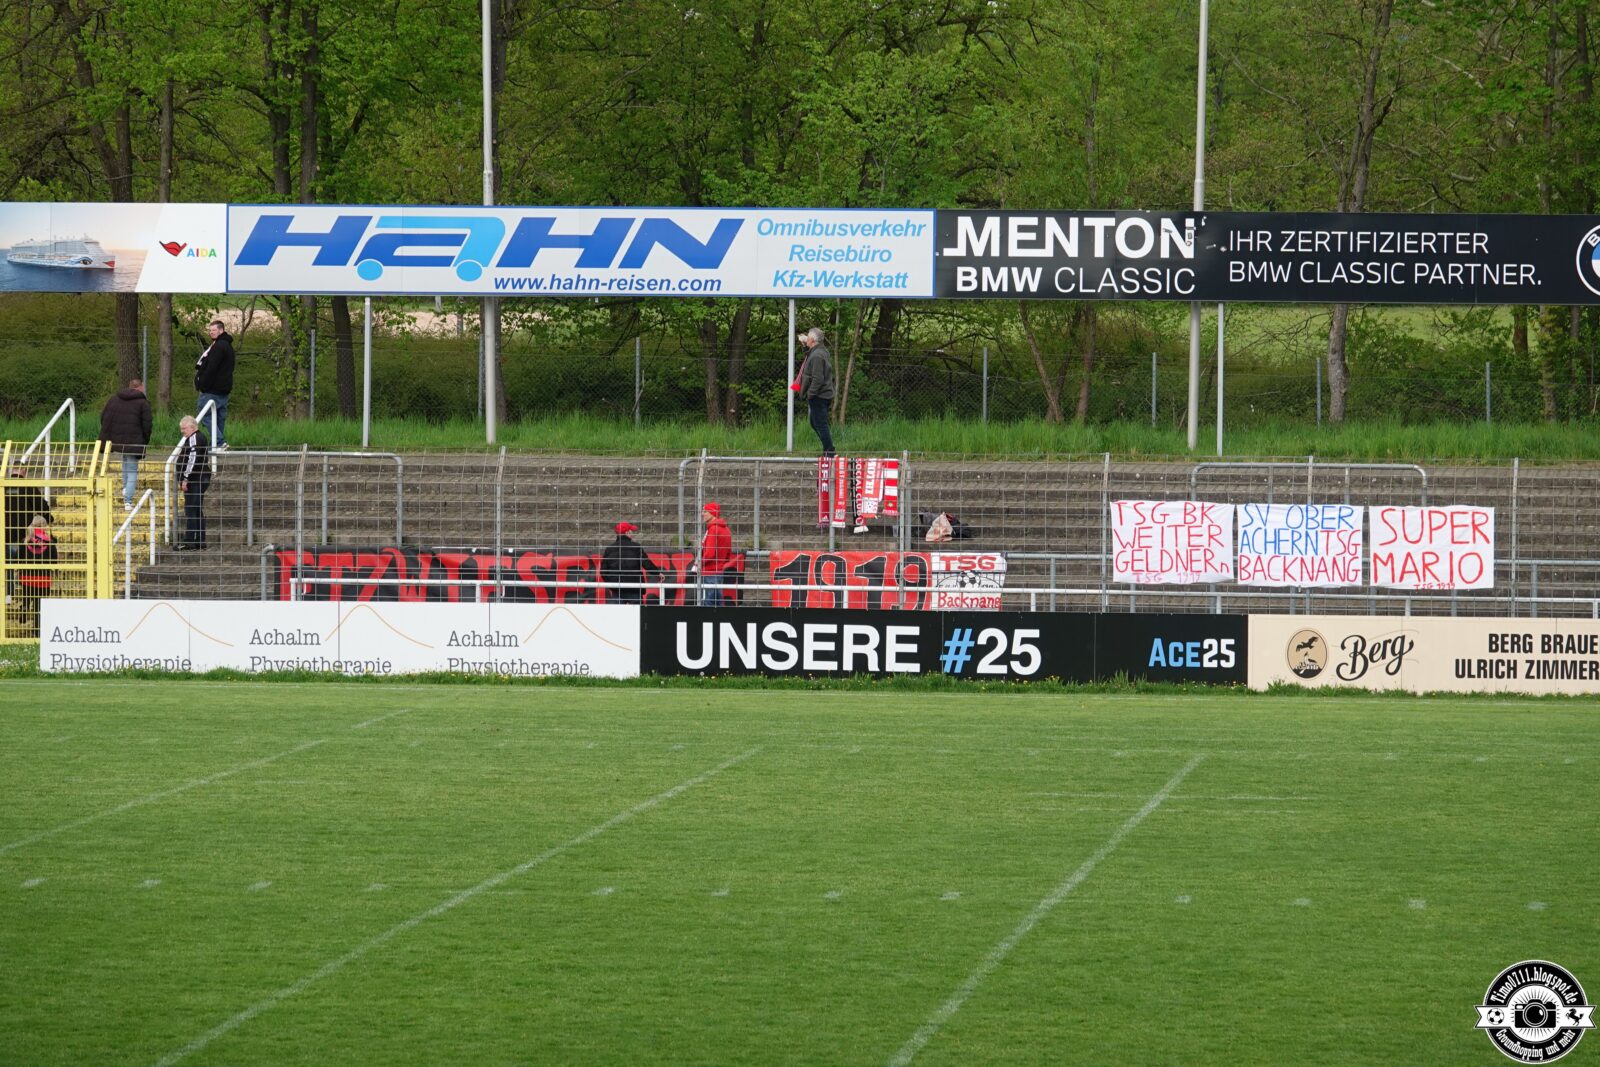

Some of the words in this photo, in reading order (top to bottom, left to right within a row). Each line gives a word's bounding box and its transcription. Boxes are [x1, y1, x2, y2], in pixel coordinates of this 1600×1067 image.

[756, 218, 927, 238] Omnibusverkehr
[942, 215, 1195, 259] MENTON
[186, 247, 217, 258] AIDA
[1229, 230, 1273, 252] IHR
[1280, 230, 1489, 254] ZERTIFIZIERTER
[788, 243, 892, 264] Reisebüro
[494, 273, 722, 294] www.hahn-reisen.com
[773, 270, 909, 290] Kfz-Werkstatt
[956, 266, 1043, 292] BMW
[1054, 266, 1196, 295] CLASSIC
[1229, 261, 1292, 283] BMW
[1300, 262, 1405, 285] CLASSIC
[1414, 263, 1542, 286] PARTNER.
[1115, 501, 1170, 526] TSG
[1183, 501, 1216, 525] BK
[1242, 503, 1270, 528] SV
[1286, 504, 1354, 530] OBER
[1114, 525, 1224, 549] WEITER
[1379, 508, 1490, 546] SUPER
[941, 556, 995, 571] TSG
[1239, 555, 1361, 583] BACKNANG
[1373, 551, 1484, 584] MARIO
[50, 626, 121, 643] Achalm
[250, 629, 321, 646] Achalm
[447, 631, 518, 648] Achalm
[1489, 633, 1533, 653] BERG
[1541, 634, 1599, 654] BRAUE
[676, 621, 921, 672] UNSERE
[941, 628, 1042, 675] #25
[1335, 634, 1414, 682] Berg
[50, 653, 192, 672] Physiotherapie
[249, 656, 392, 674] Physiotherapie
[447, 658, 590, 676] Physiotherapie
[1455, 659, 1517, 679] ULRICH
[1525, 659, 1600, 680] ZIMMER
